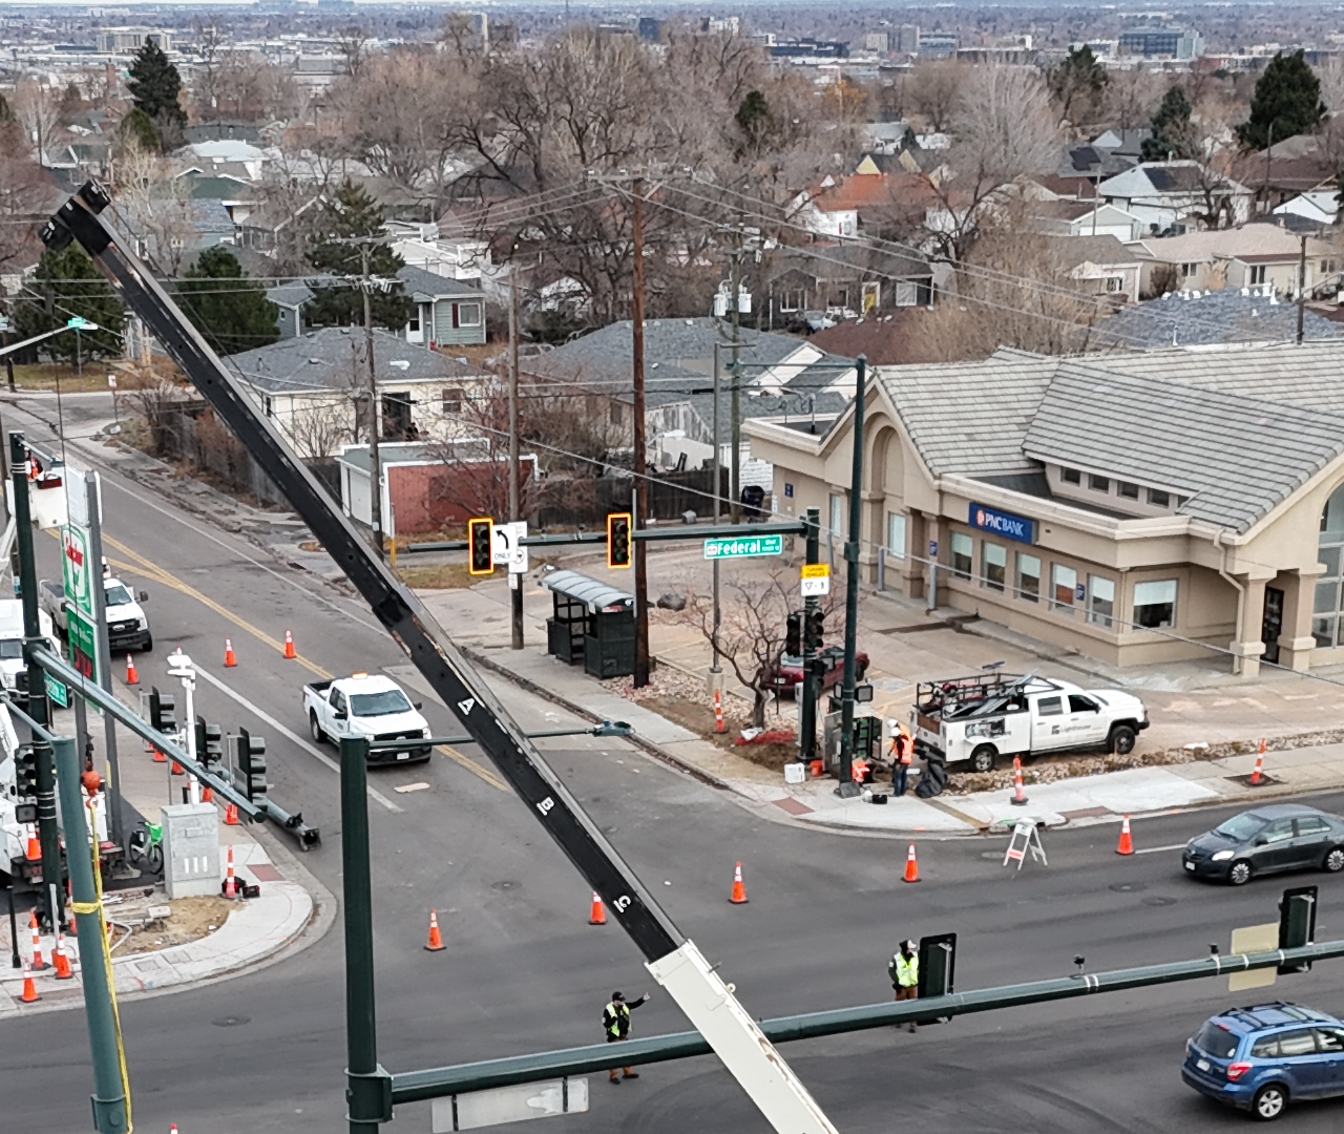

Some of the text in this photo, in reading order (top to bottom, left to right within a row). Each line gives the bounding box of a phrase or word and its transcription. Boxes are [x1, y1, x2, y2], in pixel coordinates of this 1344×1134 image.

[717, 539, 761, 555] Federal
[494, 552, 511, 560] ONLY
[459, 698, 475, 715] A
[537, 797, 555, 815] B
[614, 895, 631, 913] C
